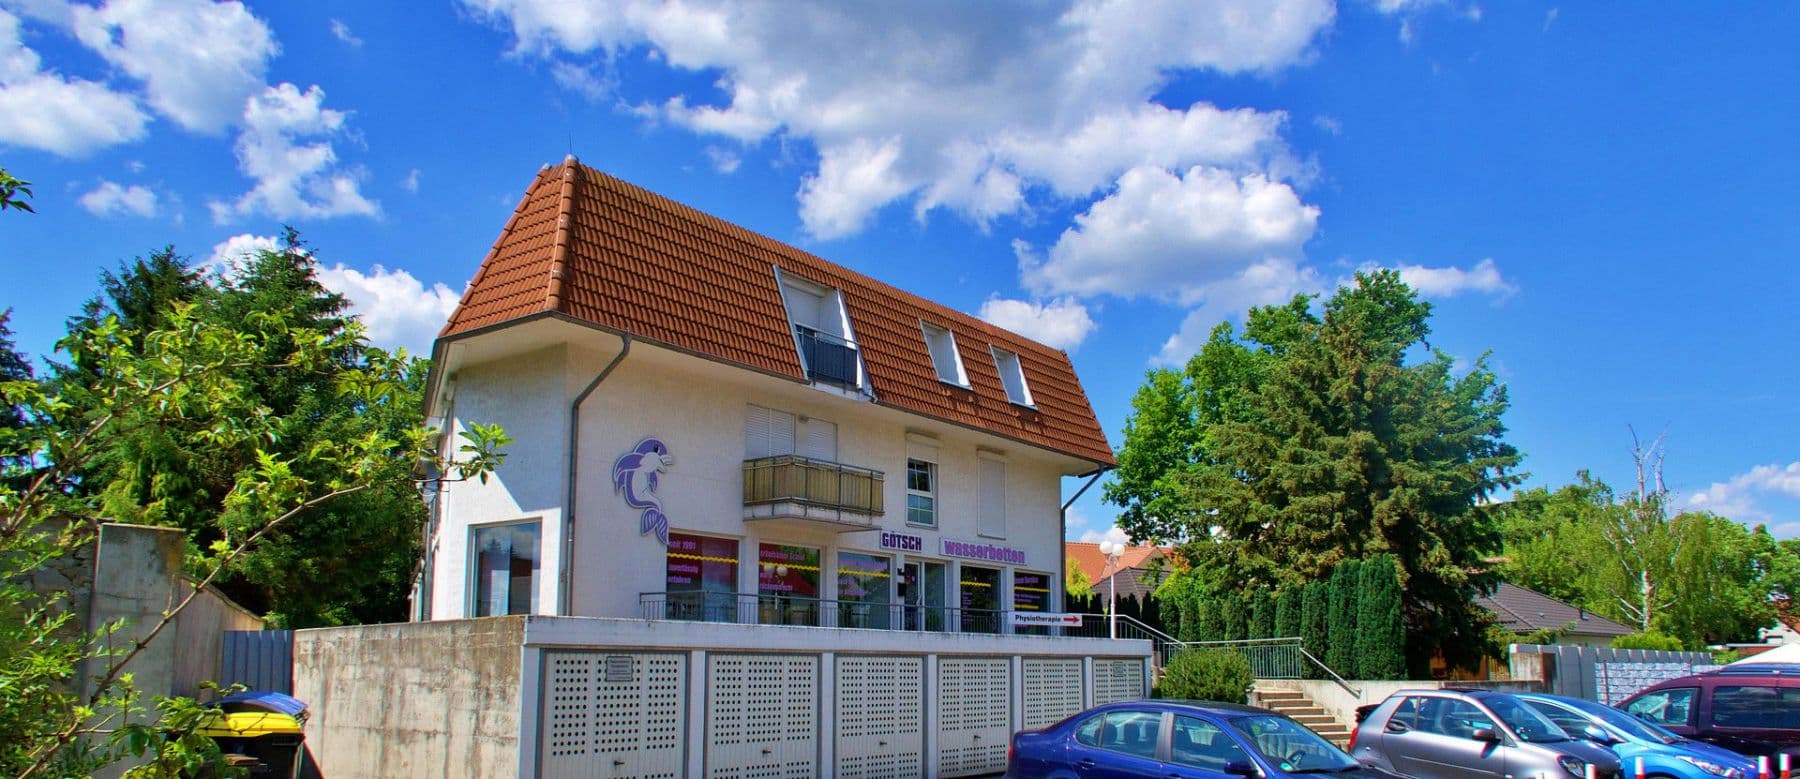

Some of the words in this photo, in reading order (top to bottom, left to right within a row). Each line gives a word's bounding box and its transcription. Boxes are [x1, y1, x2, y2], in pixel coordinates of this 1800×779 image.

[882, 531, 922, 551] GÖTSCH
[944, 540, 1026, 564] wasserbetten
[1015, 614, 1061, 625] Physiotherapie
